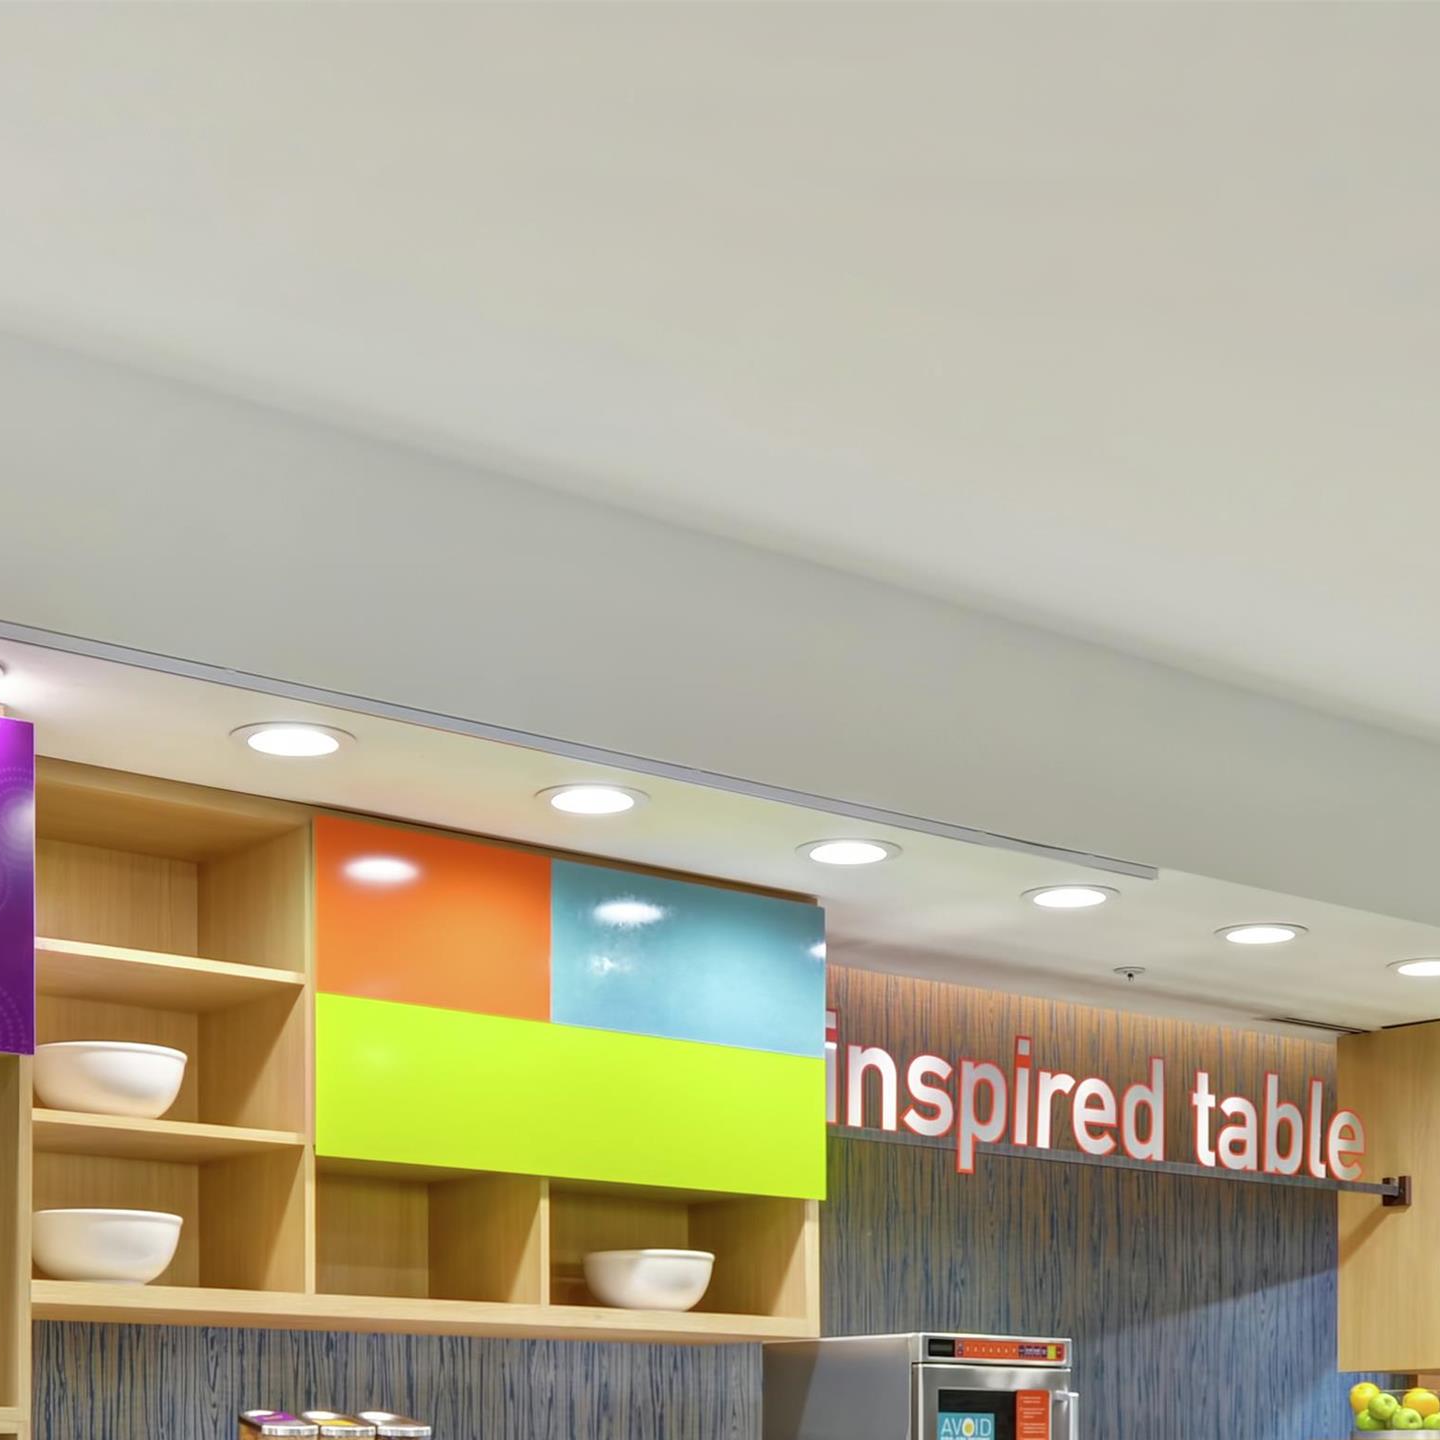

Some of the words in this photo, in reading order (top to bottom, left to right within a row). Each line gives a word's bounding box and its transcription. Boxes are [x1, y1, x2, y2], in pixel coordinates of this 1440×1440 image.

[826, 1009, 1165, 1174] inspired
[1191, 1070, 1366, 1181] table
[940, 1417, 992, 1437] AVOID
